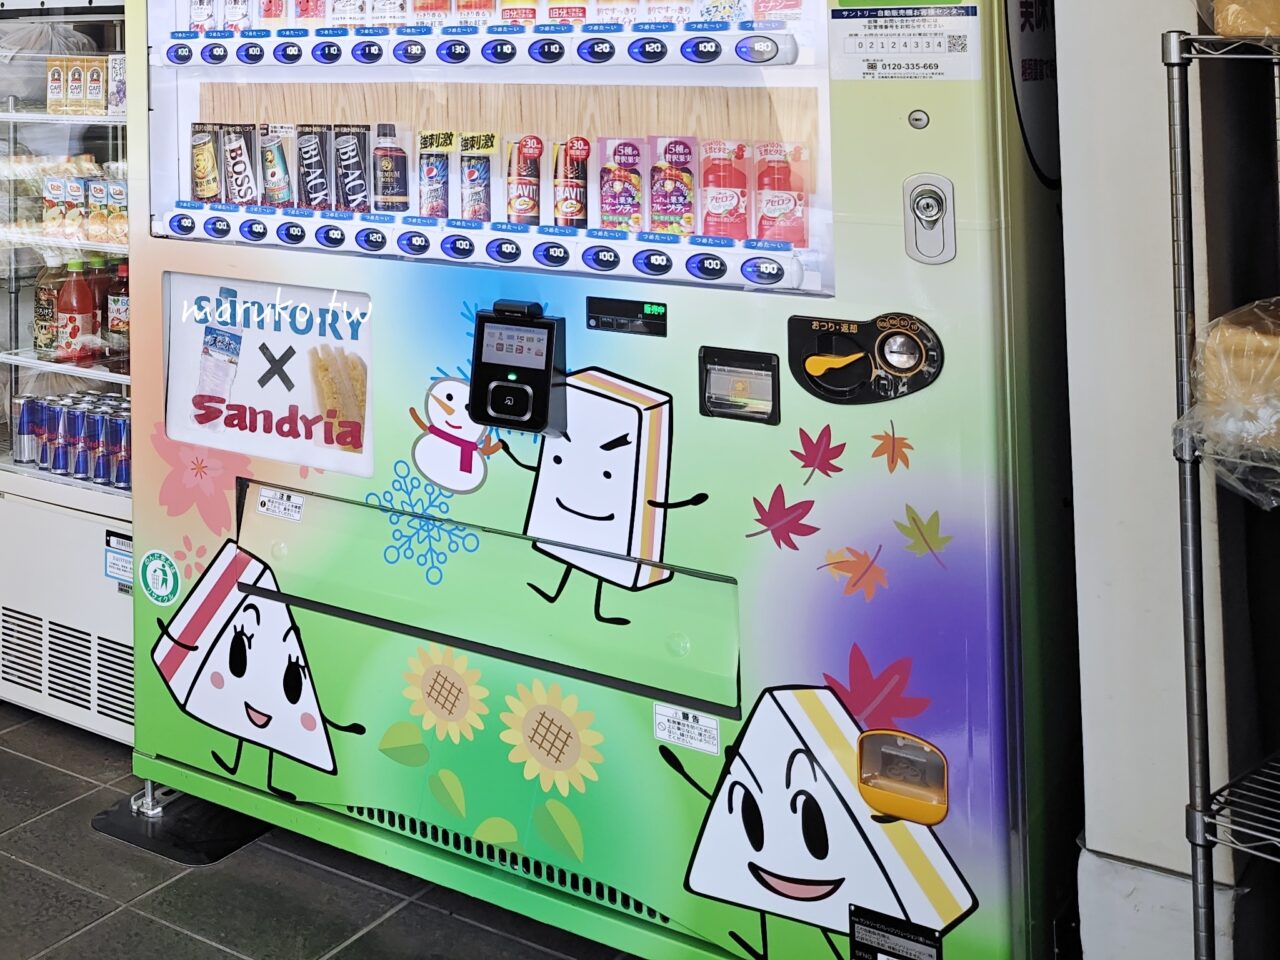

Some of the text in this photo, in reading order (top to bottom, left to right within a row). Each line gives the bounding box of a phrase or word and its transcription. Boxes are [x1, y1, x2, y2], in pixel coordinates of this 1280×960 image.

[178, 48, 189, 56] 100
[213, 48, 224, 56] 100
[286, 47, 298, 55] 100
[325, 47, 338, 55] 110
[408, 45, 421, 54] 130
[451, 45, 466, 54] 130
[497, 44, 512, 53] 110
[544, 44, 560, 53] 110
[594, 43, 610, 52] 120
[645, 43, 661, 52] 120
[698, 43, 716, 52] 100
[420, 132, 454, 150] 強刺激
[460, 133, 496, 152] 強刺激
[618, 146, 638, 155] 5種の
[669, 145, 689, 154] 5種の
[230, 144, 253, 200] BOSS
[301, 143, 329, 206] BLACK
[339, 143, 368, 208] BLACK
[710, 195, 735, 204] アセロラ
[765, 197, 792, 207] アセロラ
[601, 204, 638, 213] フルーツティー
[652, 204, 690, 213] フルーツティー
[181, 219, 192, 227] 100
[215, 221, 227, 230] 100
[252, 224, 264, 233] 100
[289, 227, 302, 236] 100
[329, 231, 341, 239] 100
[369, 233, 382, 242] 120
[411, 237, 425, 246] 100
[455, 241, 469, 249] 100
[501, 244, 516, 253] 100
[549, 248, 564, 257] 100
[599, 252, 614, 261] 100
[650, 256, 666, 265] 100
[704, 260, 721, 269] 100
[760, 264, 778, 274] 100
[191, 394, 363, 449] Sandria
[682, 711, 699, 724] 警告
